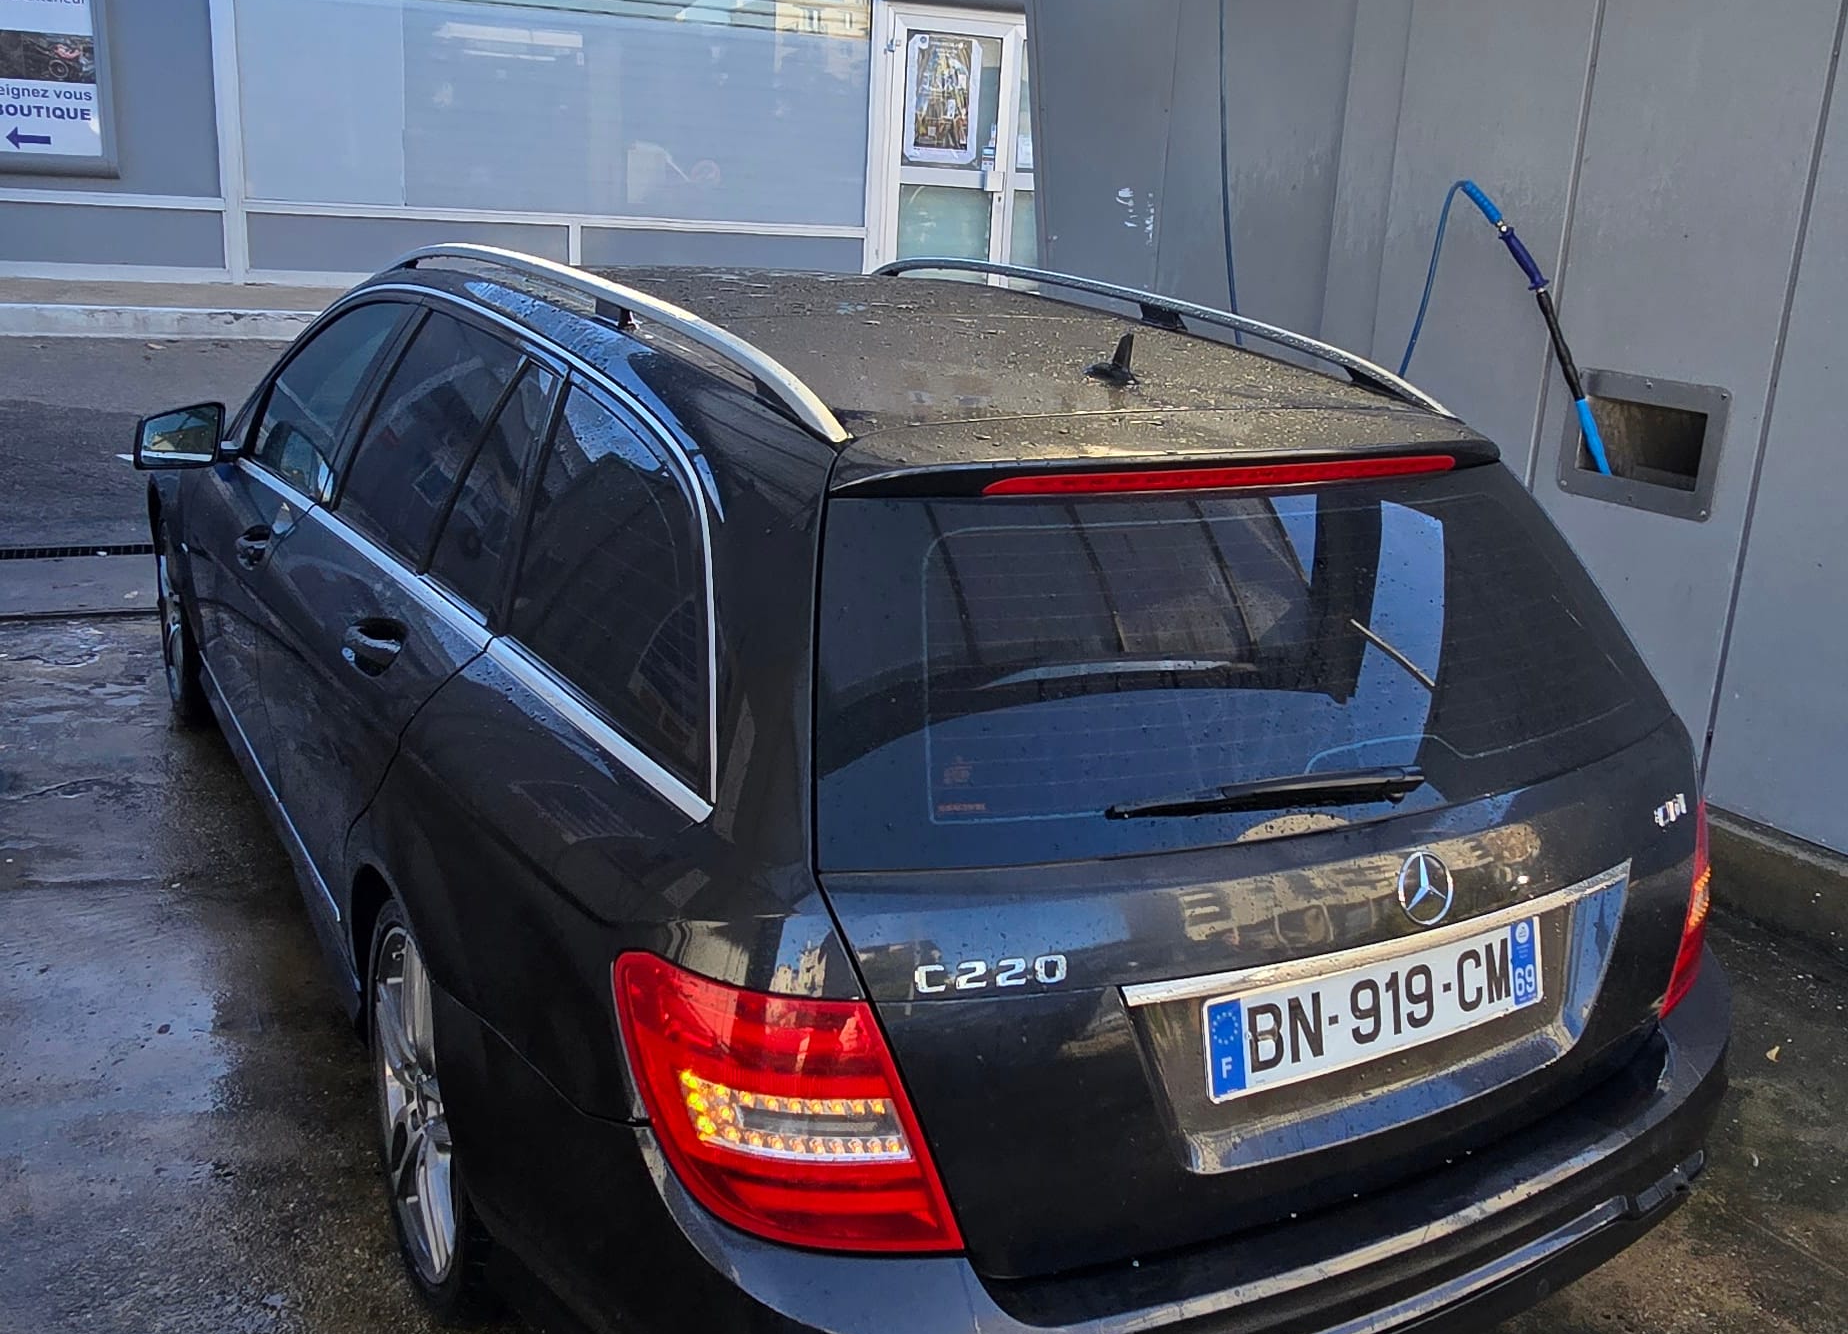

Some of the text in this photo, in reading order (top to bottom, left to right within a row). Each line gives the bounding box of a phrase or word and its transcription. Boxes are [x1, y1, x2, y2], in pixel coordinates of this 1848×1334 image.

[53, 89, 92, 101] vous
[1515, 964, 1535, 997] 69
[1221, 1056, 1233, 1079] F
